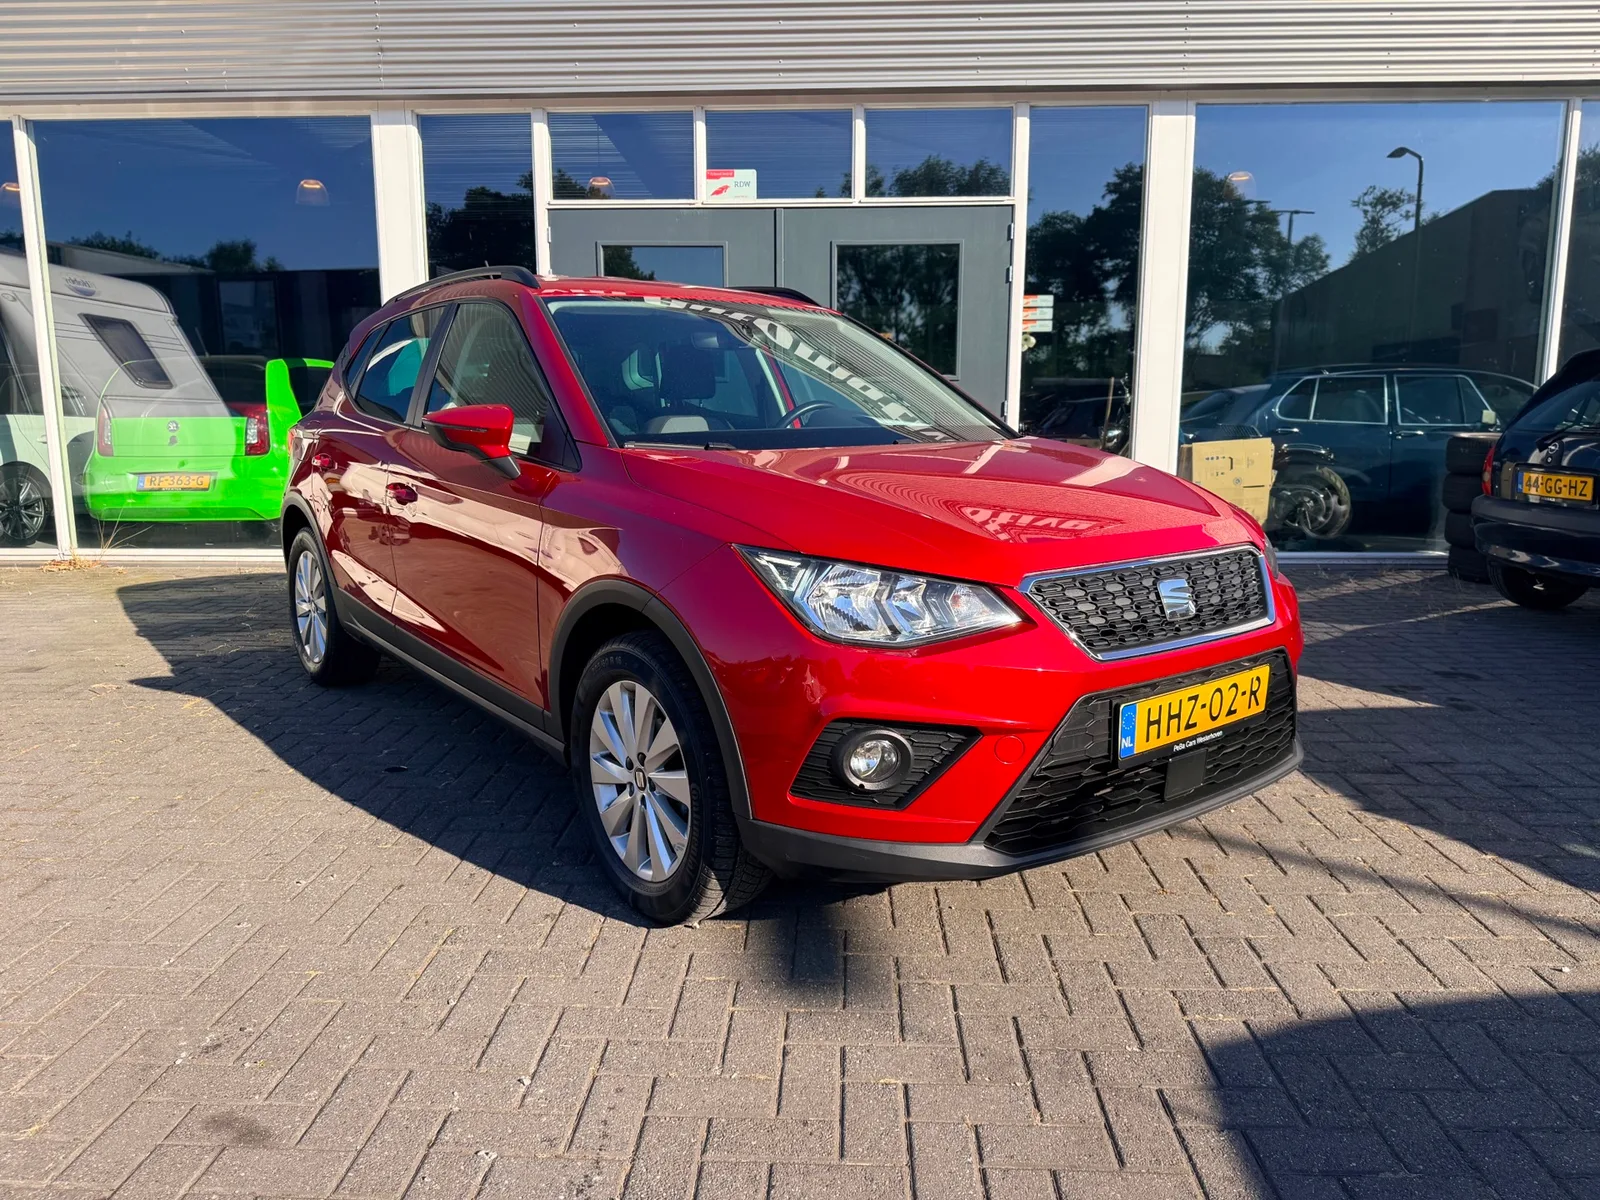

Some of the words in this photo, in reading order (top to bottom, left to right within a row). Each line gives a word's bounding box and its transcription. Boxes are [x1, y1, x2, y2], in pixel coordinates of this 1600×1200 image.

[149, 475, 205, 487] RF-363-G
[1525, 475, 1589, 498] 44-GG-HZ
[1146, 675, 1262, 743] HHZ-02-R
[1121, 736, 1133, 749] NL
